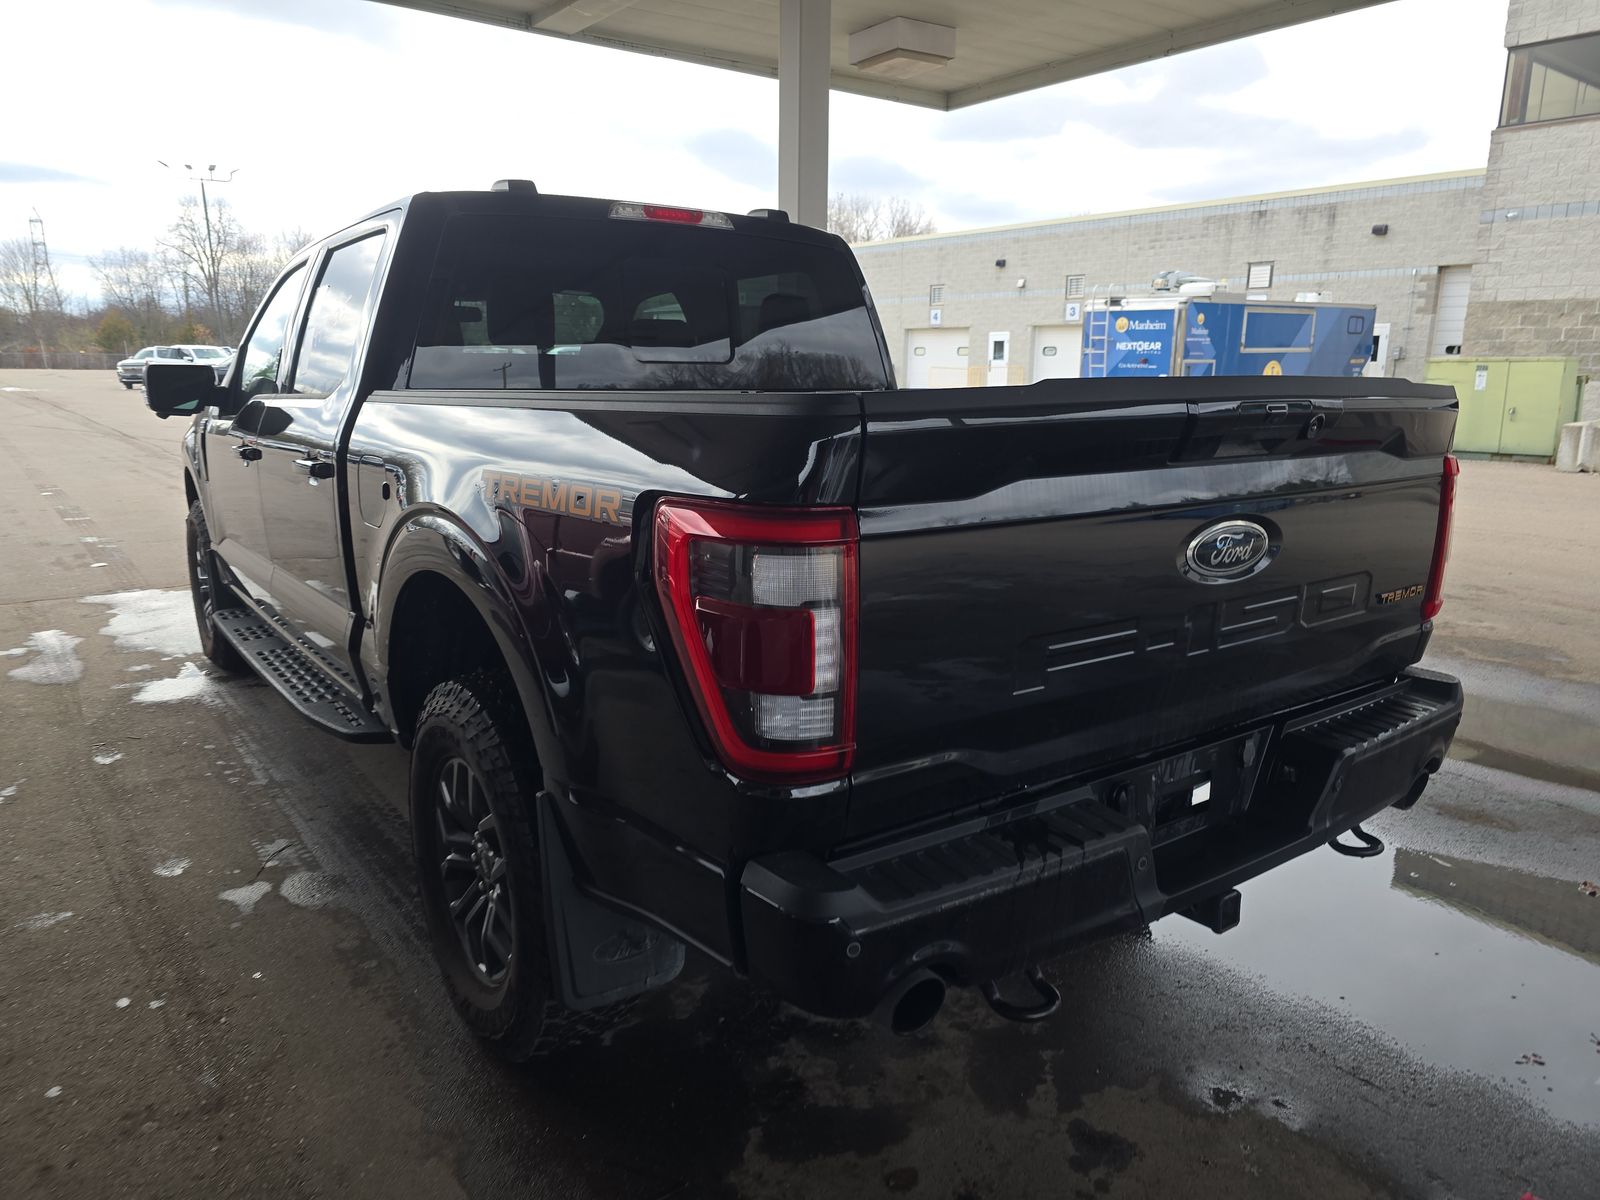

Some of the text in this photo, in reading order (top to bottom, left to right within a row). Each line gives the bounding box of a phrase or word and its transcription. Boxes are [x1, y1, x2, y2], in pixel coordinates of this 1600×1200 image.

[1129, 320, 1167, 330] Manheim
[1116, 341, 1162, 351] NEXTGEAR
[482, 470, 624, 525] TREMOR
[1211, 533, 1254, 567] Ford
[1381, 585, 1423, 604] TREMOR
